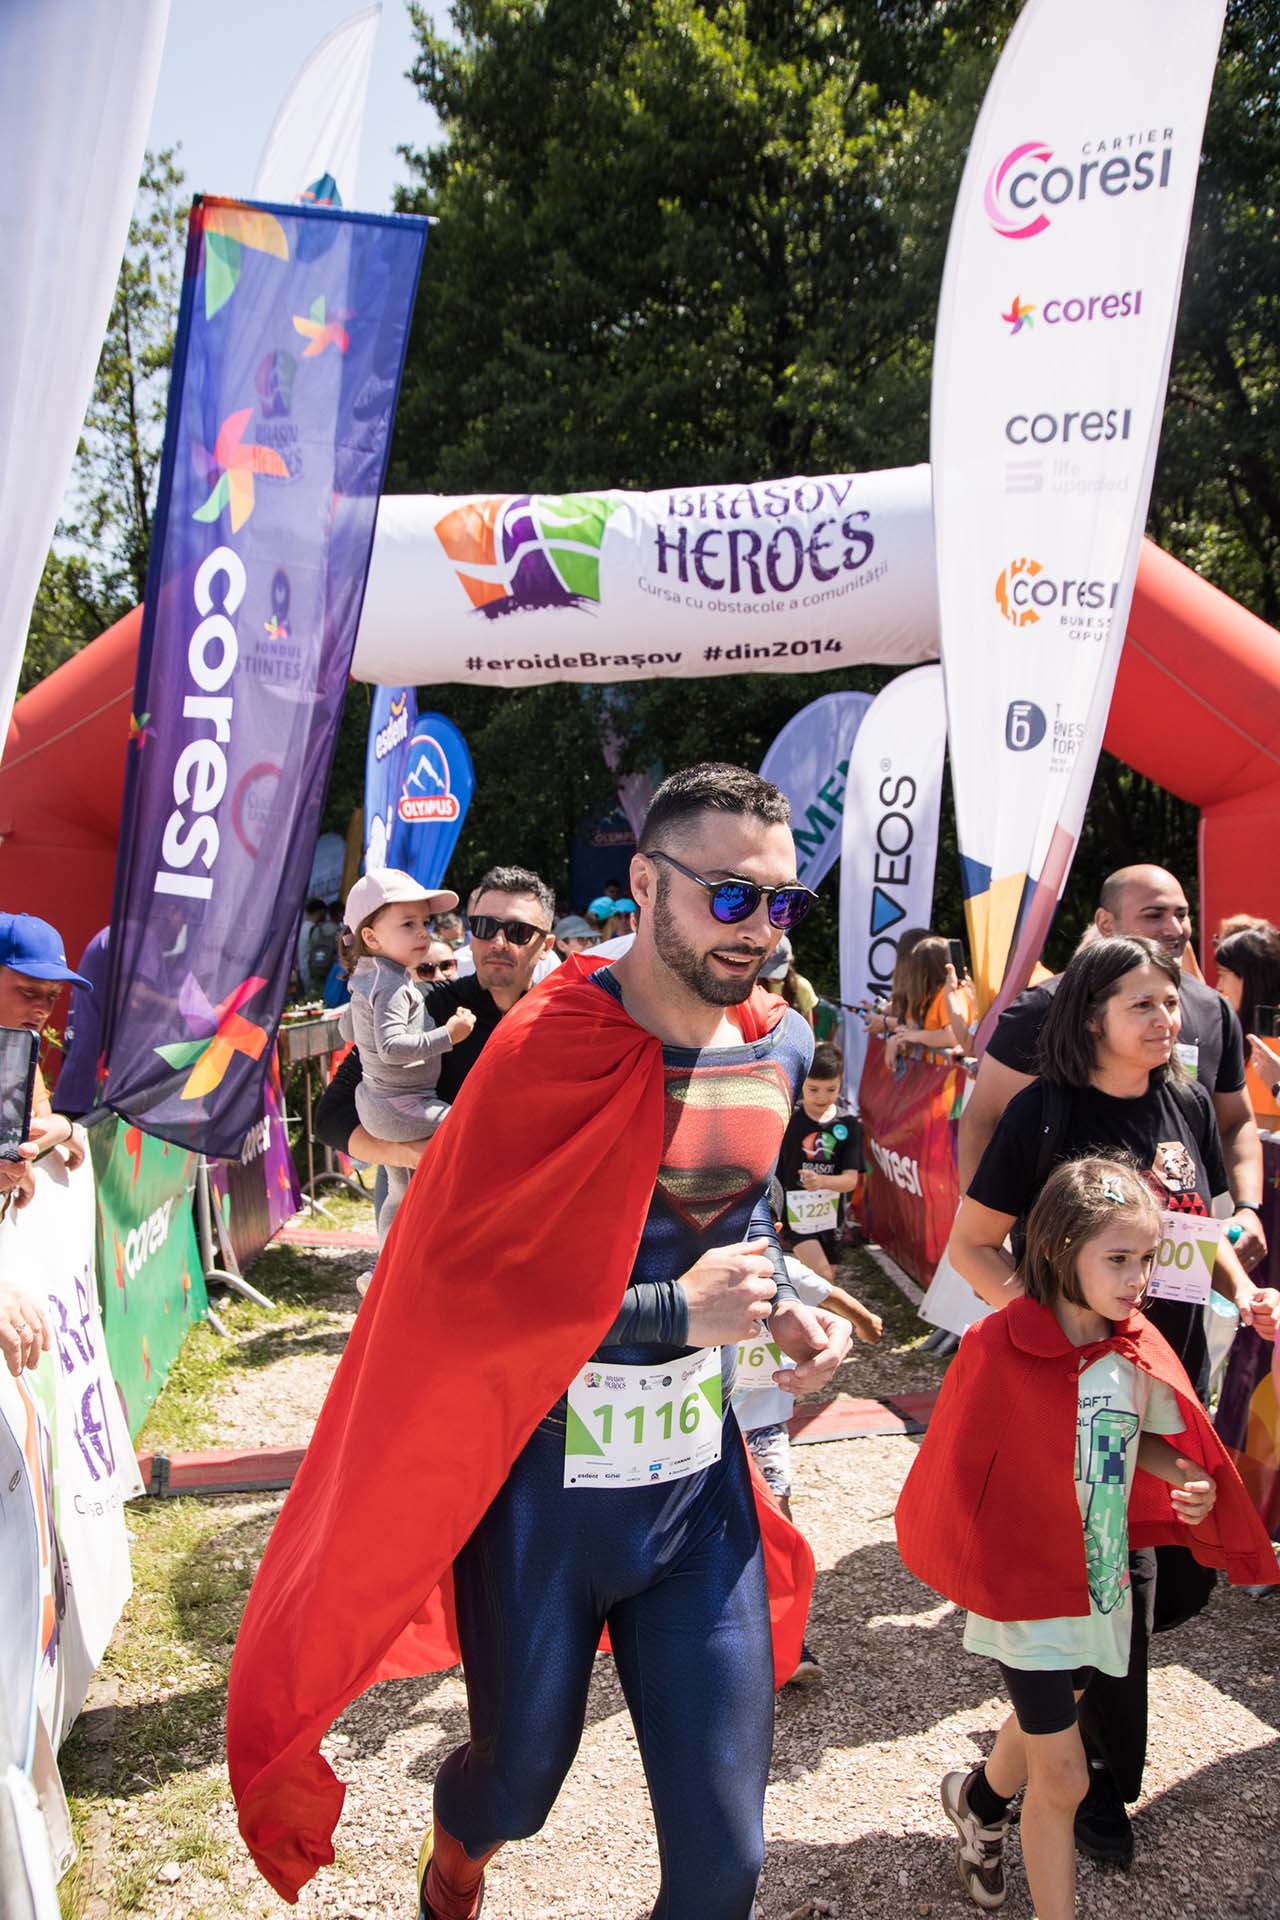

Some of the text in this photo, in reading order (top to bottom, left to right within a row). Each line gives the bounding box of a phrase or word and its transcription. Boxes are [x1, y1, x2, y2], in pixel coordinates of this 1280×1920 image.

[1082, 128, 1174, 155] CARTIER
[654, 510, 875, 595] HEROES
[638, 576, 681, 604] Cursa
[685, 596, 704, 611] cu
[708, 596, 785, 614] obstacole
[789, 599, 799, 610] a
[703, 638, 843, 662] #din2014
[402, 799, 453, 818] OLYMPUS
[797, 1202, 830, 1218] 1223
[1156, 1238, 1195, 1271] 00
[593, 1391, 701, 1444] 1116
